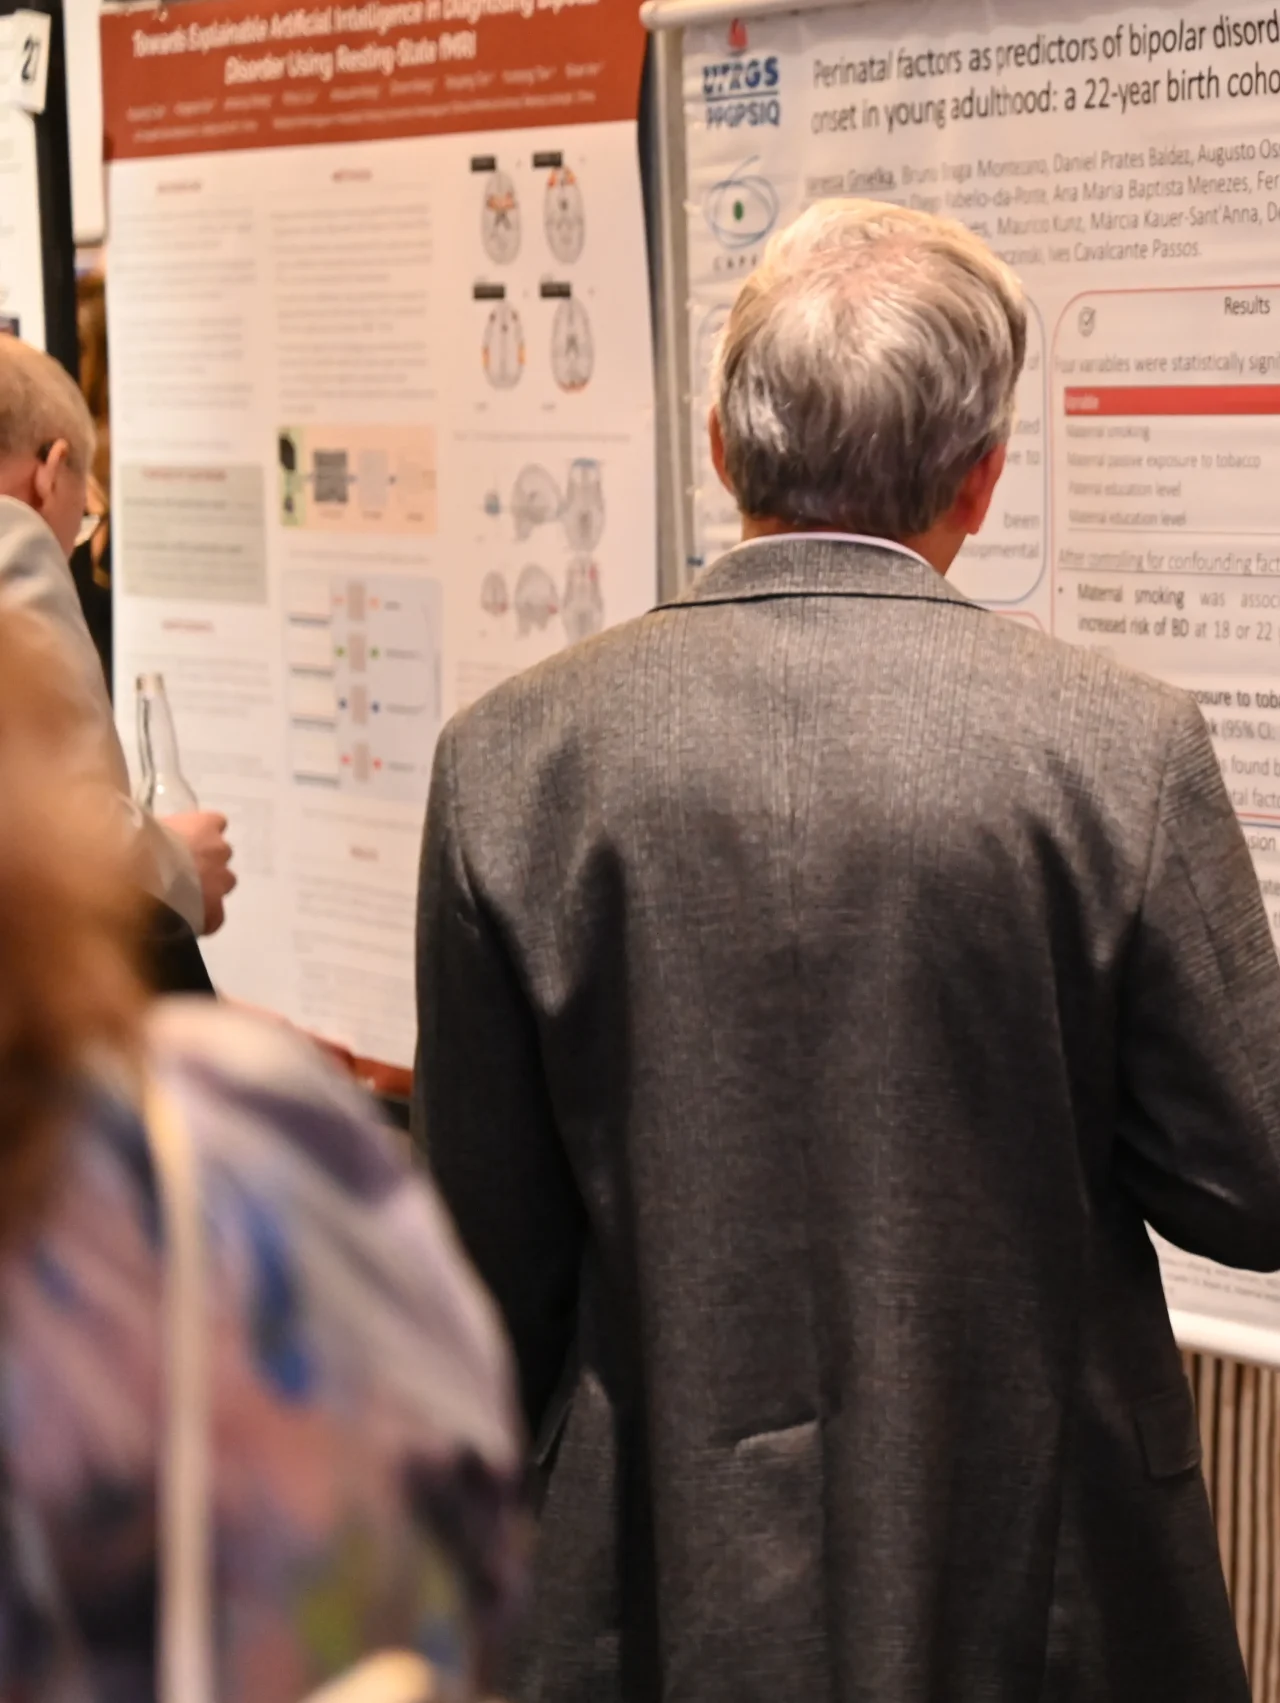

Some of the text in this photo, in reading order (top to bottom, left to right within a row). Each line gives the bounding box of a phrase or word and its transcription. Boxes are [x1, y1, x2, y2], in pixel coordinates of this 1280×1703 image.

[813, 51, 893, 89] Perinatal
[897, 45, 962, 81] factors
[968, 46, 991, 72] as
[996, 33, 1098, 76] predictors
[1102, 24, 1124, 60] of
[1129, 19, 1207, 62] bipolar
[224, 54, 285, 85] Disorder
[287, 47, 333, 82] Using
[811, 102, 856, 134] onset
[862, 97, 880, 128] in
[884, 97, 946, 134] young
[951, 80, 1058, 120] adulthood:
[1064, 86, 1076, 111] a
[1084, 77, 1160, 114] 22-year
[1166, 65, 1220, 103] birth
[1053, 151, 1096, 174] Daniel
[1101, 149, 1144, 171] Prates
[1198, 142, 1255, 168] Augusto
[1053, 184, 1077, 203] Ana
[1082, 180, 1123, 202] Maria
[1128, 178, 1183, 202] Baptista
[1187, 175, 1252, 197] Menezes,
[1074, 241, 1148, 263] Cavalcante
[1224, 295, 1271, 316] Results
[1134, 356, 1168, 373] were
[1171, 350, 1244, 374] statistically
[1146, 454, 1198, 471] exposure
[1201, 453, 1212, 468] to
[1216, 453, 1261, 469] tobacco
[1156, 481, 1181, 498] level
[1161, 510, 1186, 527] level
[1147, 549, 1164, 566] for
[1168, 550, 1252, 576] confounding
[1134, 587, 1185, 610] smoking
[1200, 591, 1226, 608] was
[1130, 617, 1149, 635] risk
[1154, 616, 1167, 636] of
[1171, 618, 1189, 637] BD
[1195, 621, 1207, 638] at
[1214, 620, 1230, 639] 18
[1236, 625, 1250, 640] or
[1256, 622, 1272, 641] 22
[1236, 692, 1250, 708] to
[1221, 719, 1255, 741] (95%
[1257, 721, 1275, 741] CI:
[1231, 755, 1270, 778] found
